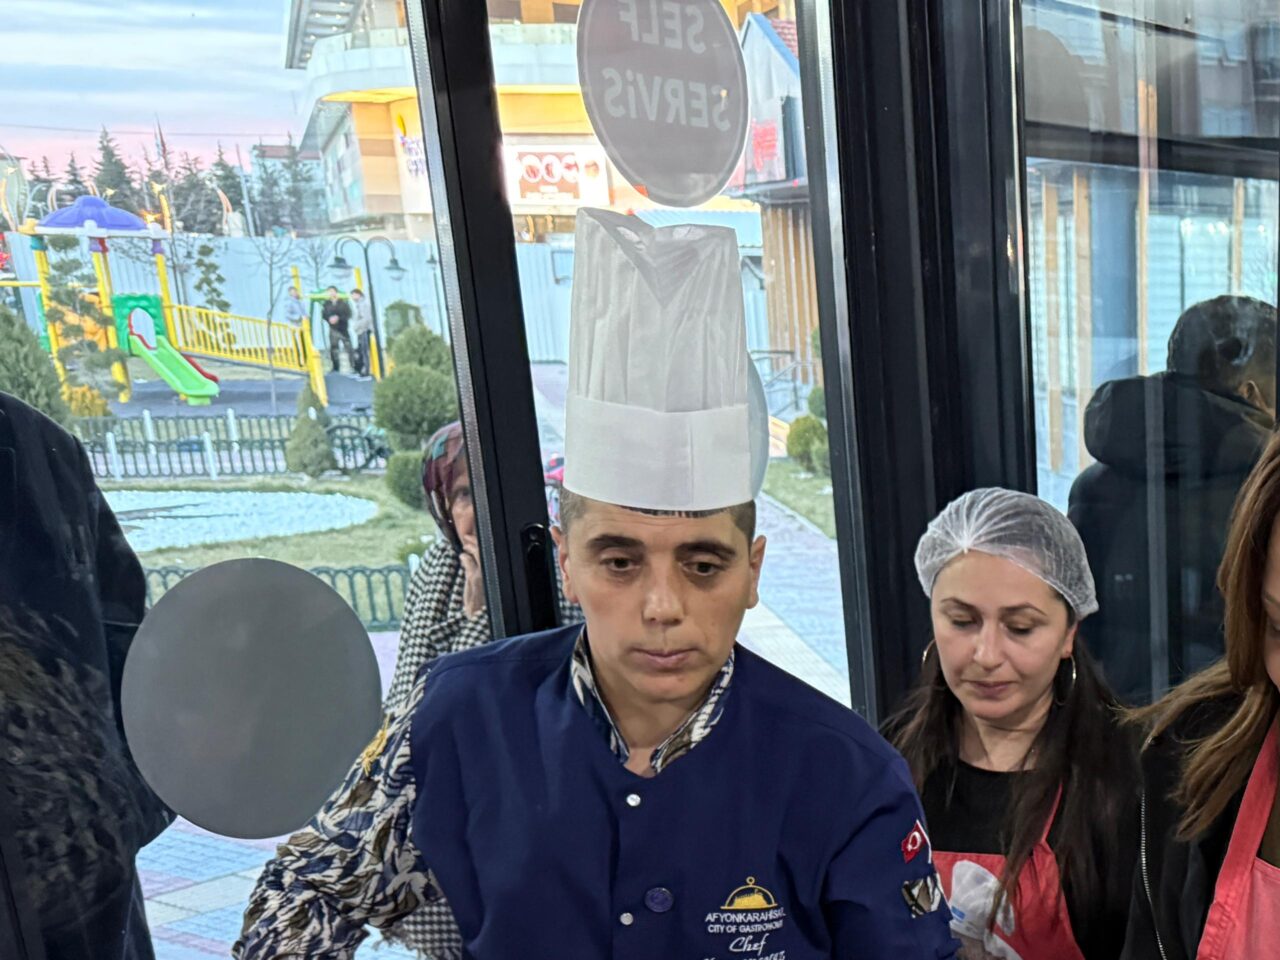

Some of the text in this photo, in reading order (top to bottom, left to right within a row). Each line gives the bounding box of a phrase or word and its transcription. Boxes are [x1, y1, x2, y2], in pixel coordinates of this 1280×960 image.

[707, 924, 724, 933] CITY
[726, 924, 737, 933] OF
[729, 933, 769, 957] Chef
